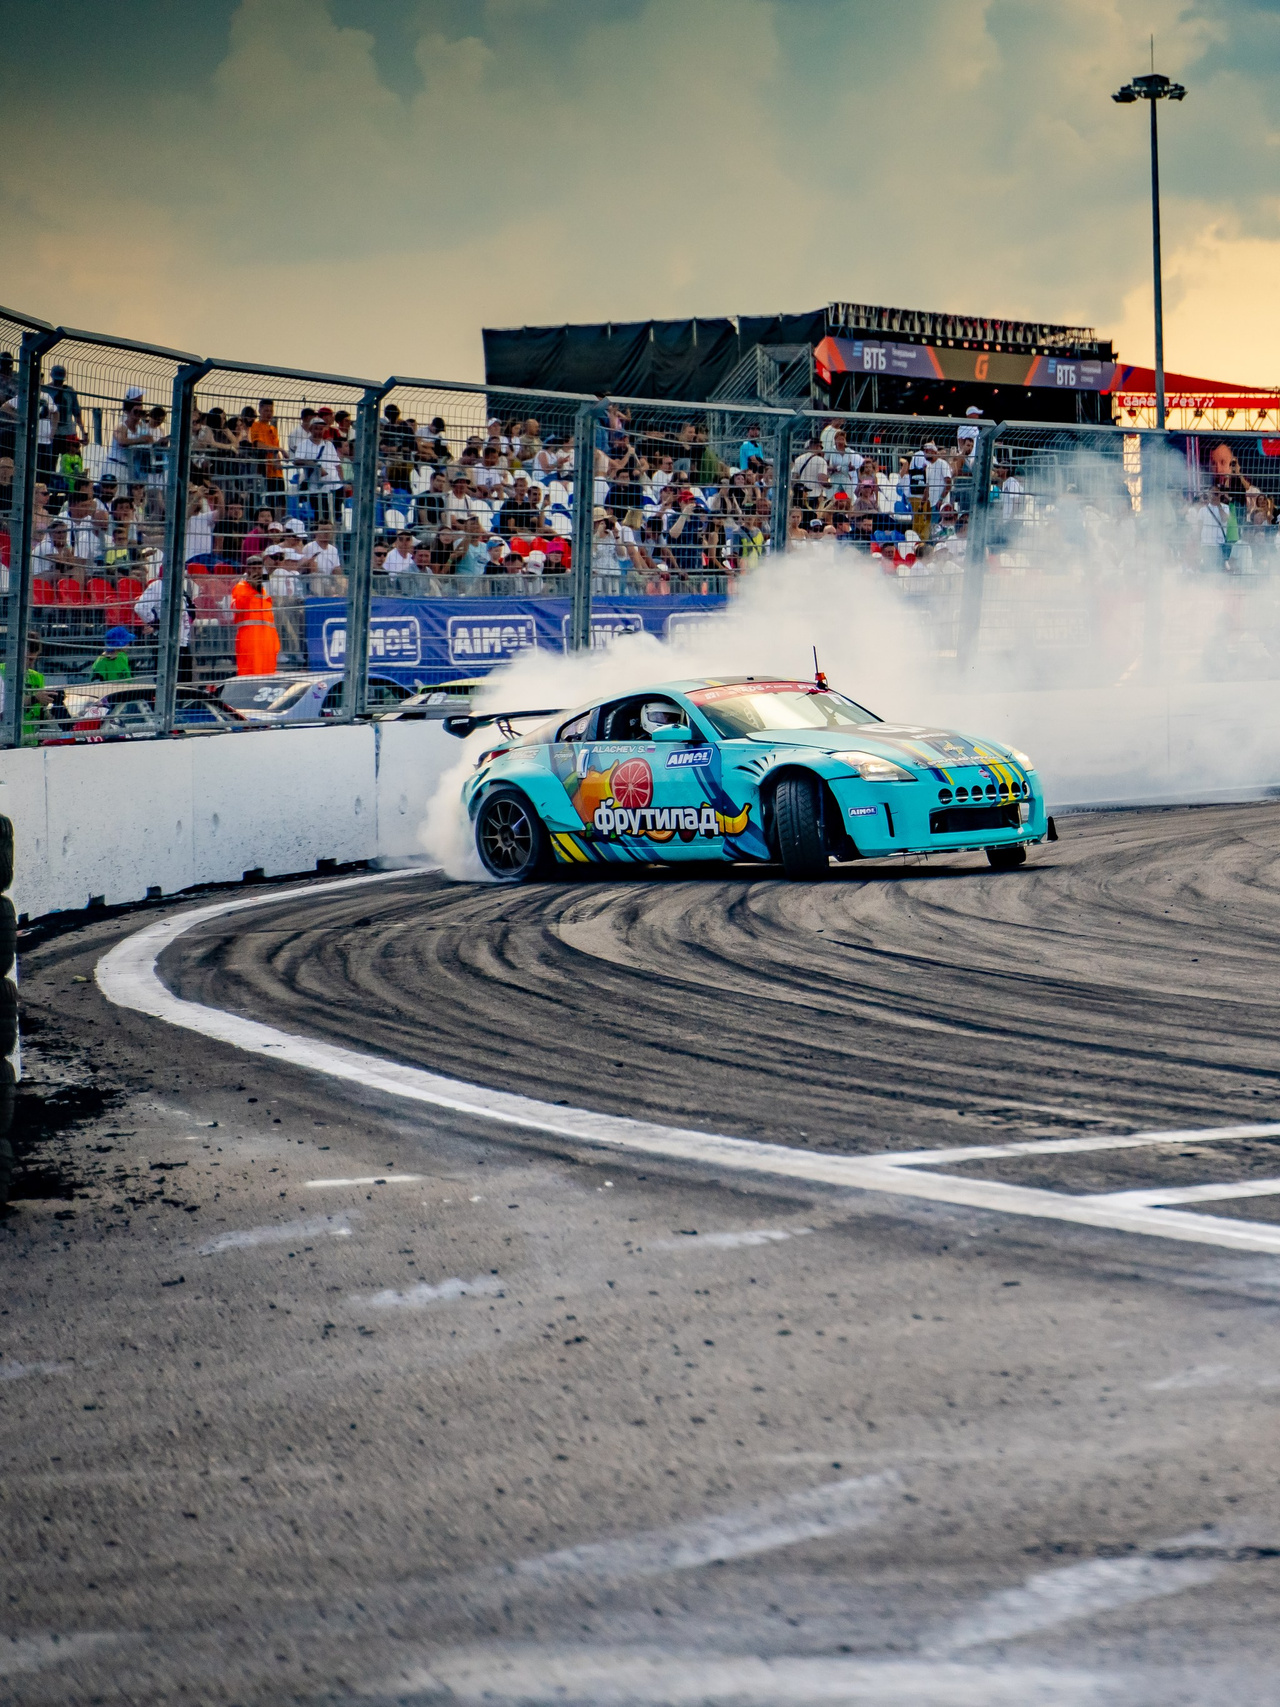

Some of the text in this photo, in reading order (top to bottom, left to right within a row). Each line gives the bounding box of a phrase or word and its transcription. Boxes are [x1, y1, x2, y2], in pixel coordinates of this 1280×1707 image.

[329, 628, 417, 658] AMOL
[453, 625, 533, 654] AIMOL
[591, 745, 636, 753] ALACHEV
[667, 752, 709, 765] AIMOL
